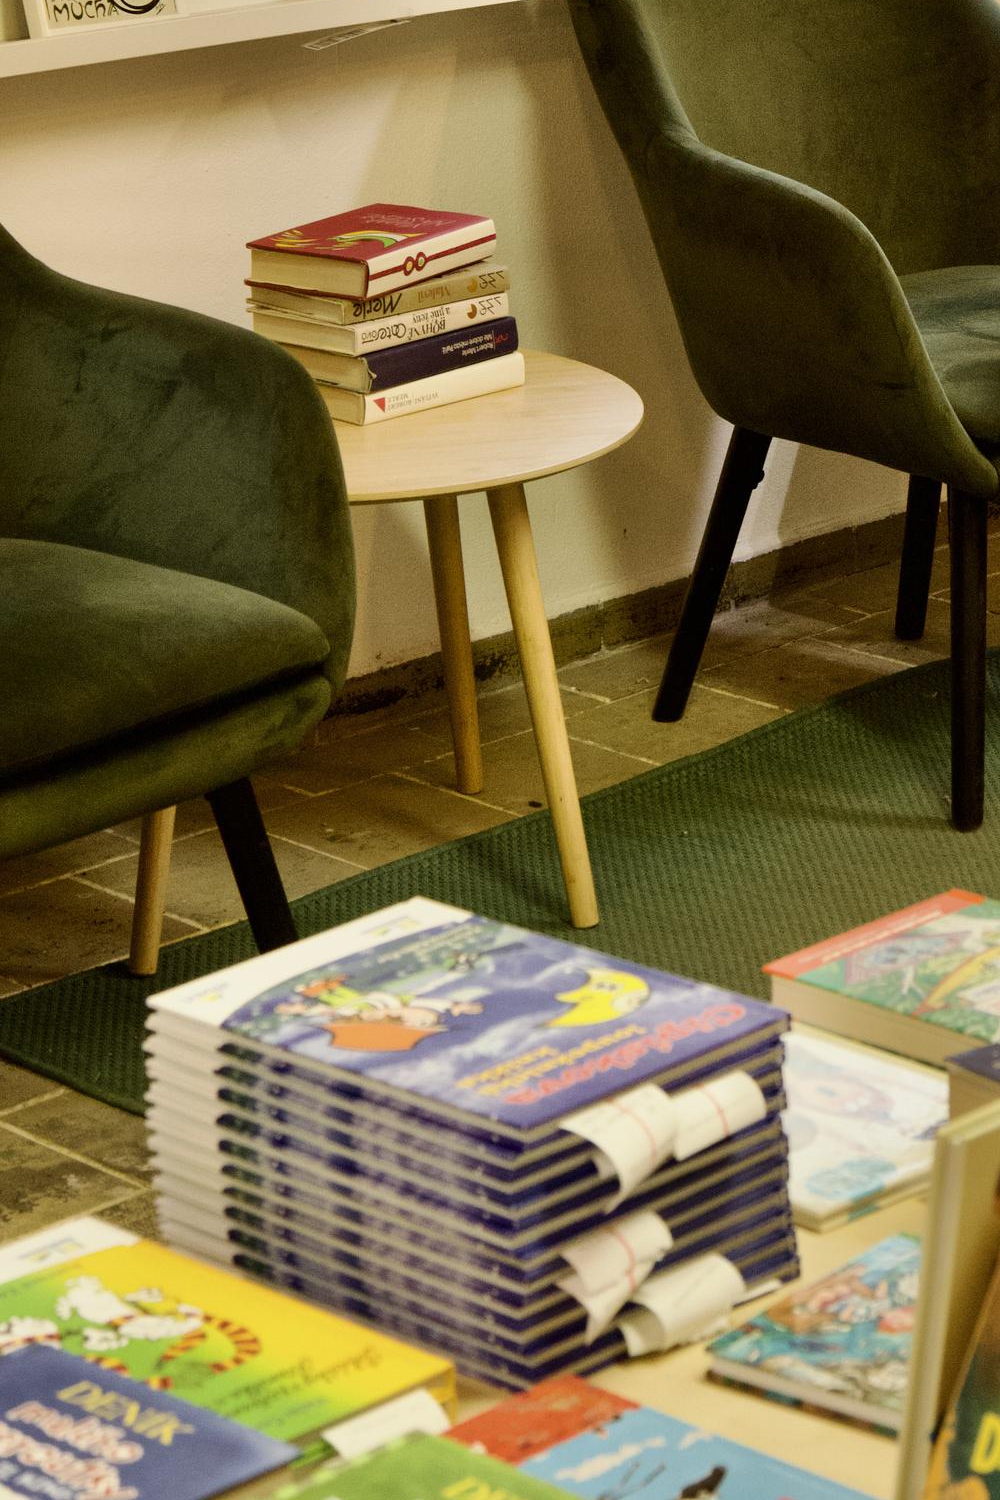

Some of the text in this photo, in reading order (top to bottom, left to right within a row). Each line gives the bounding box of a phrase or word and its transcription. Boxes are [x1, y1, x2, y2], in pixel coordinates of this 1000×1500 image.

[53, 0, 119, 22] MUCHA
[417, 283, 450, 302] Malevil
[353, 293, 402, 319] Merle
[408, 316, 446, 341] BOHYNĚ
